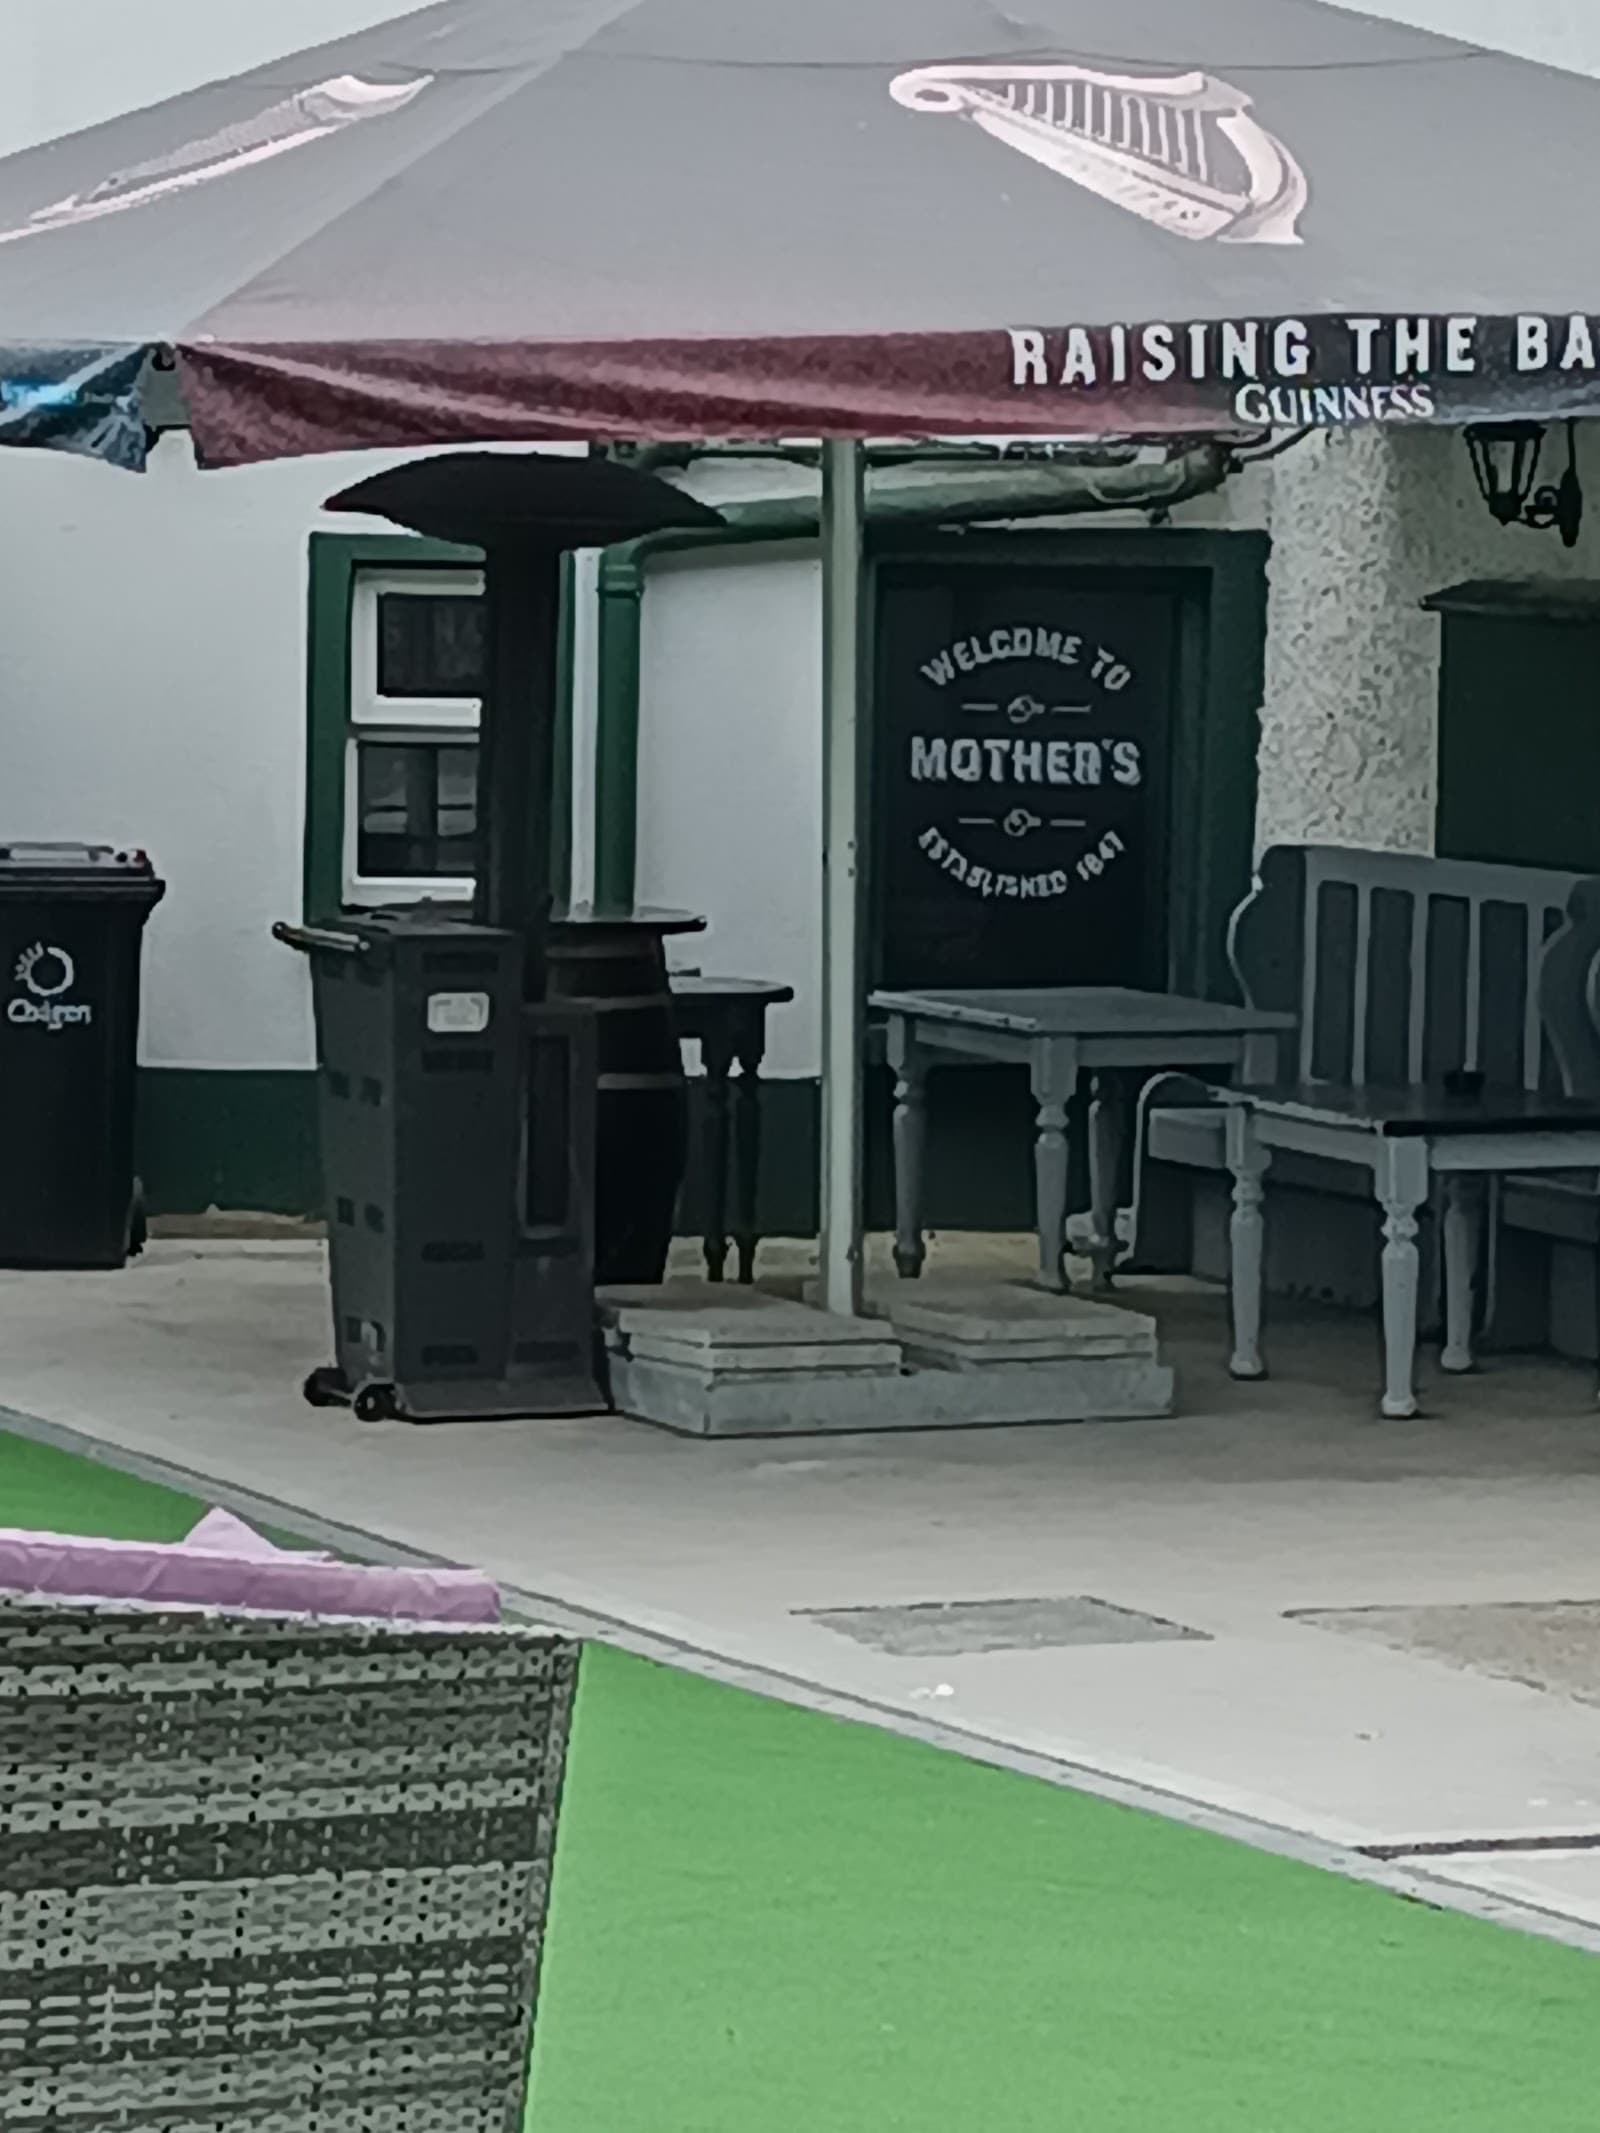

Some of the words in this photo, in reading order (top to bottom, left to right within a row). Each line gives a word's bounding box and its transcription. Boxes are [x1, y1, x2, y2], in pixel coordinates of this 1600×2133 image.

[1008, 320, 1309, 385] RAISING
[1347, 316, 1476, 374] THE
[1234, 383, 1434, 424] GUINNESS
[920, 627, 1082, 686] WELCOME
[1091, 647, 1131, 690] TO
[911, 736, 1141, 785] MOTHER'S
